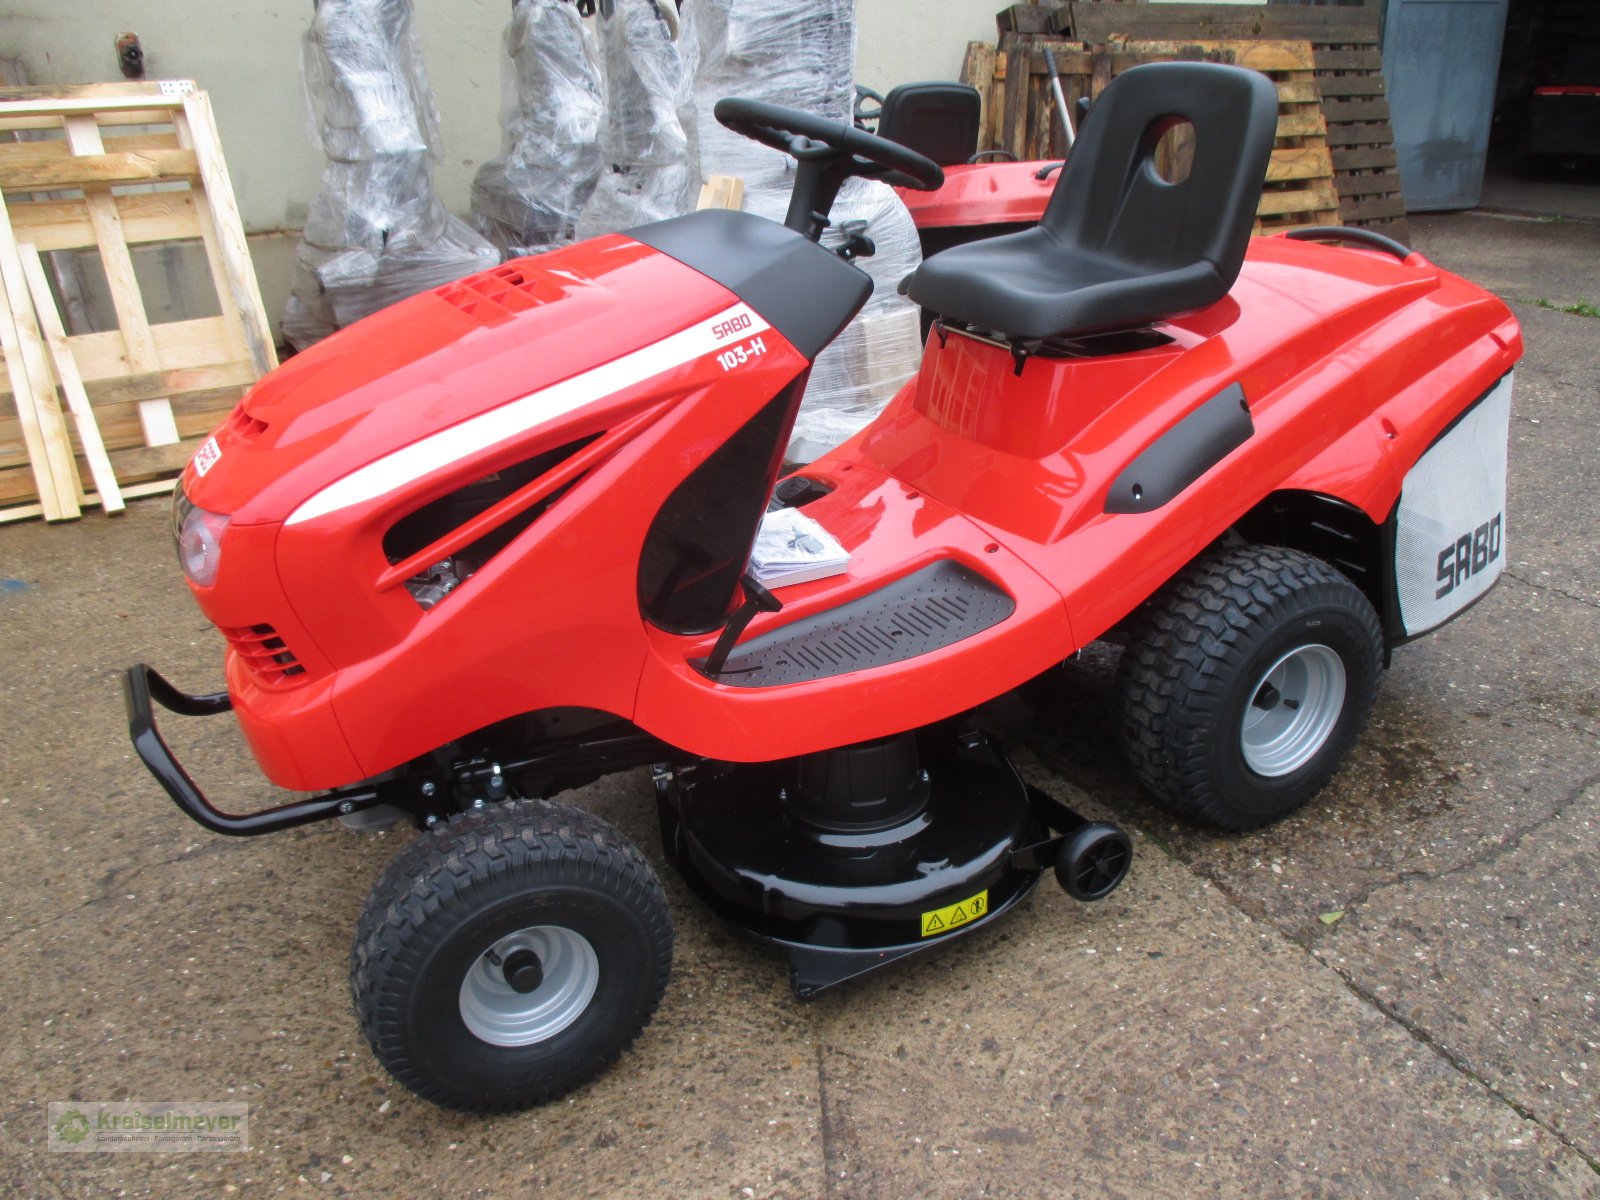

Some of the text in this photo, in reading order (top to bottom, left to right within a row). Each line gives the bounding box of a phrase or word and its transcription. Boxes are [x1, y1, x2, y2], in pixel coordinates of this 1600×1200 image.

[711, 313, 752, 340] SABO
[716, 336, 767, 371] 103-H
[1436, 511, 1501, 599] SABO
